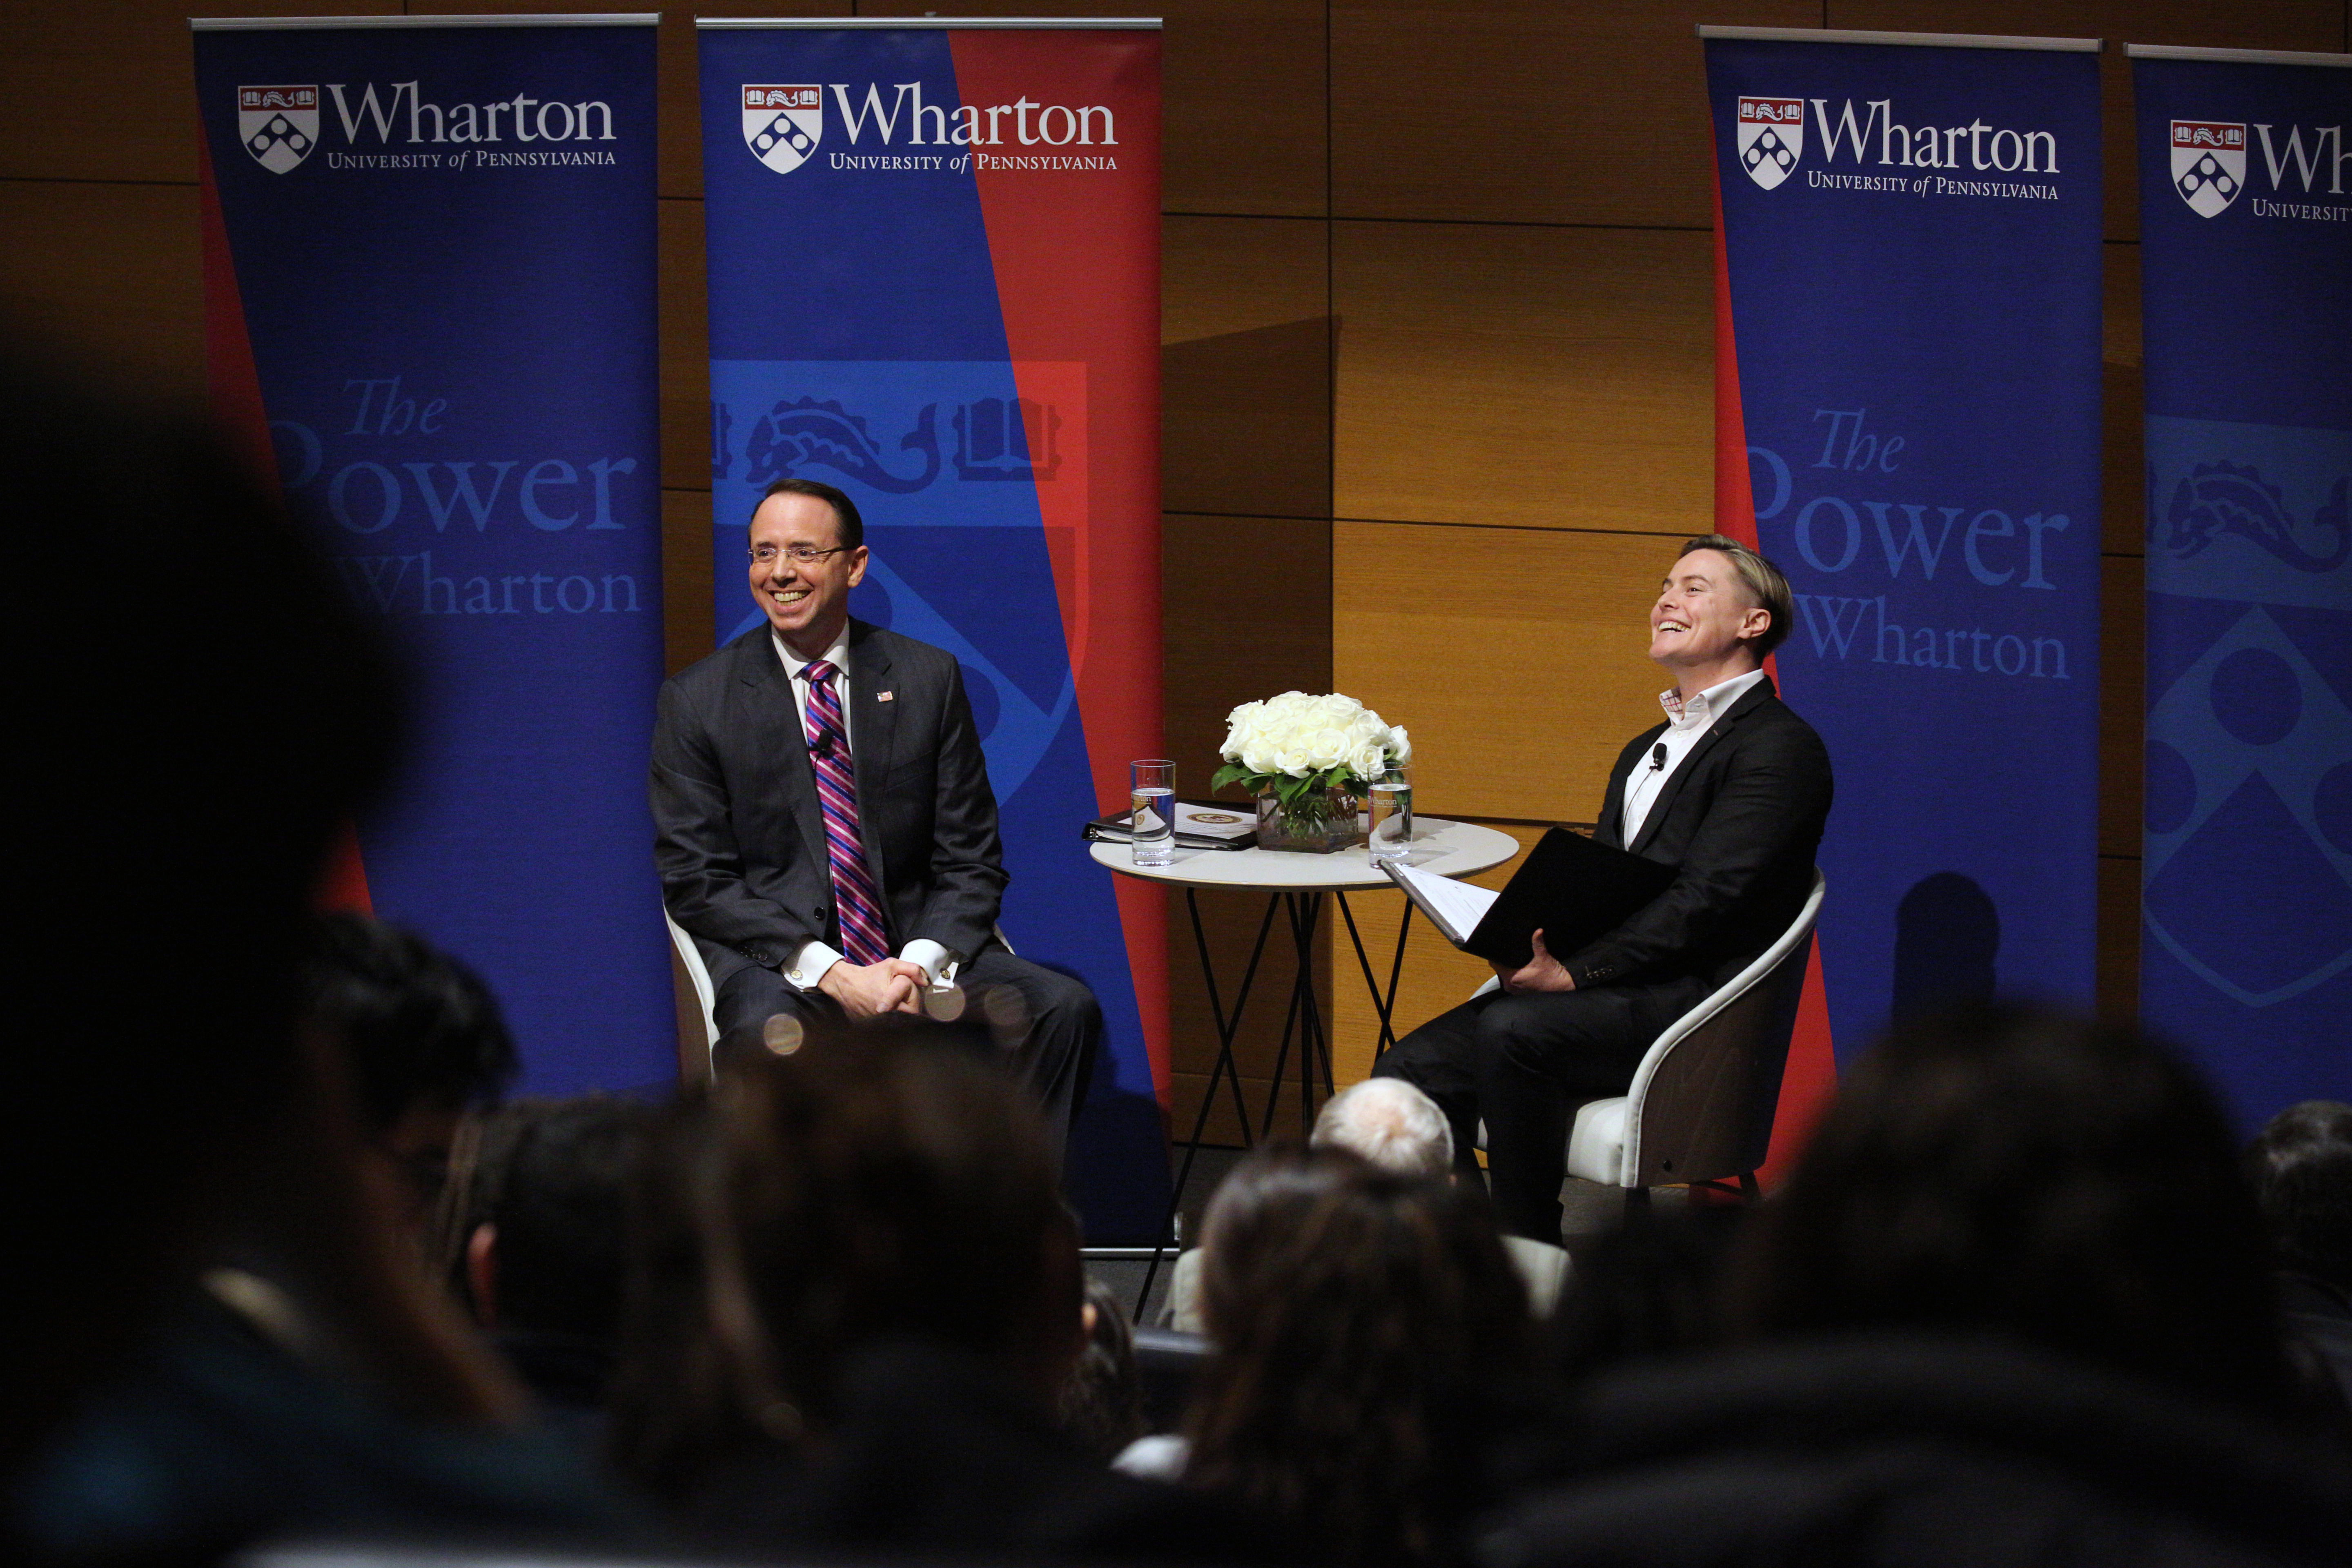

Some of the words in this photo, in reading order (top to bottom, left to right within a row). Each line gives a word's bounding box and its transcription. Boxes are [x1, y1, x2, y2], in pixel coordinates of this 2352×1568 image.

[326, 80, 617, 144] Wharton
[829, 81, 1118, 145] Wharton
[1809, 98, 2060, 173] Wharton
[328, 152, 441, 169] UNIVERSITY
[449, 150, 471, 172] of
[476, 150, 616, 167] PENNSYLVANIA
[829, 153, 942, 170] UNIVERSITY
[950, 153, 972, 174] of
[978, 153, 1117, 170] PENNSYLVANIA
[1807, 170, 1908, 192] UNIVERSITY
[1913, 176, 1932, 198] of
[1936, 176, 2059, 200] PENNSYLVANIA
[2252, 198, 2352, 222] UNIVERSIT
[342, 374, 448, 437] The
[1811, 408, 1905, 473] The
[1791, 593, 2071, 679] Wharton
